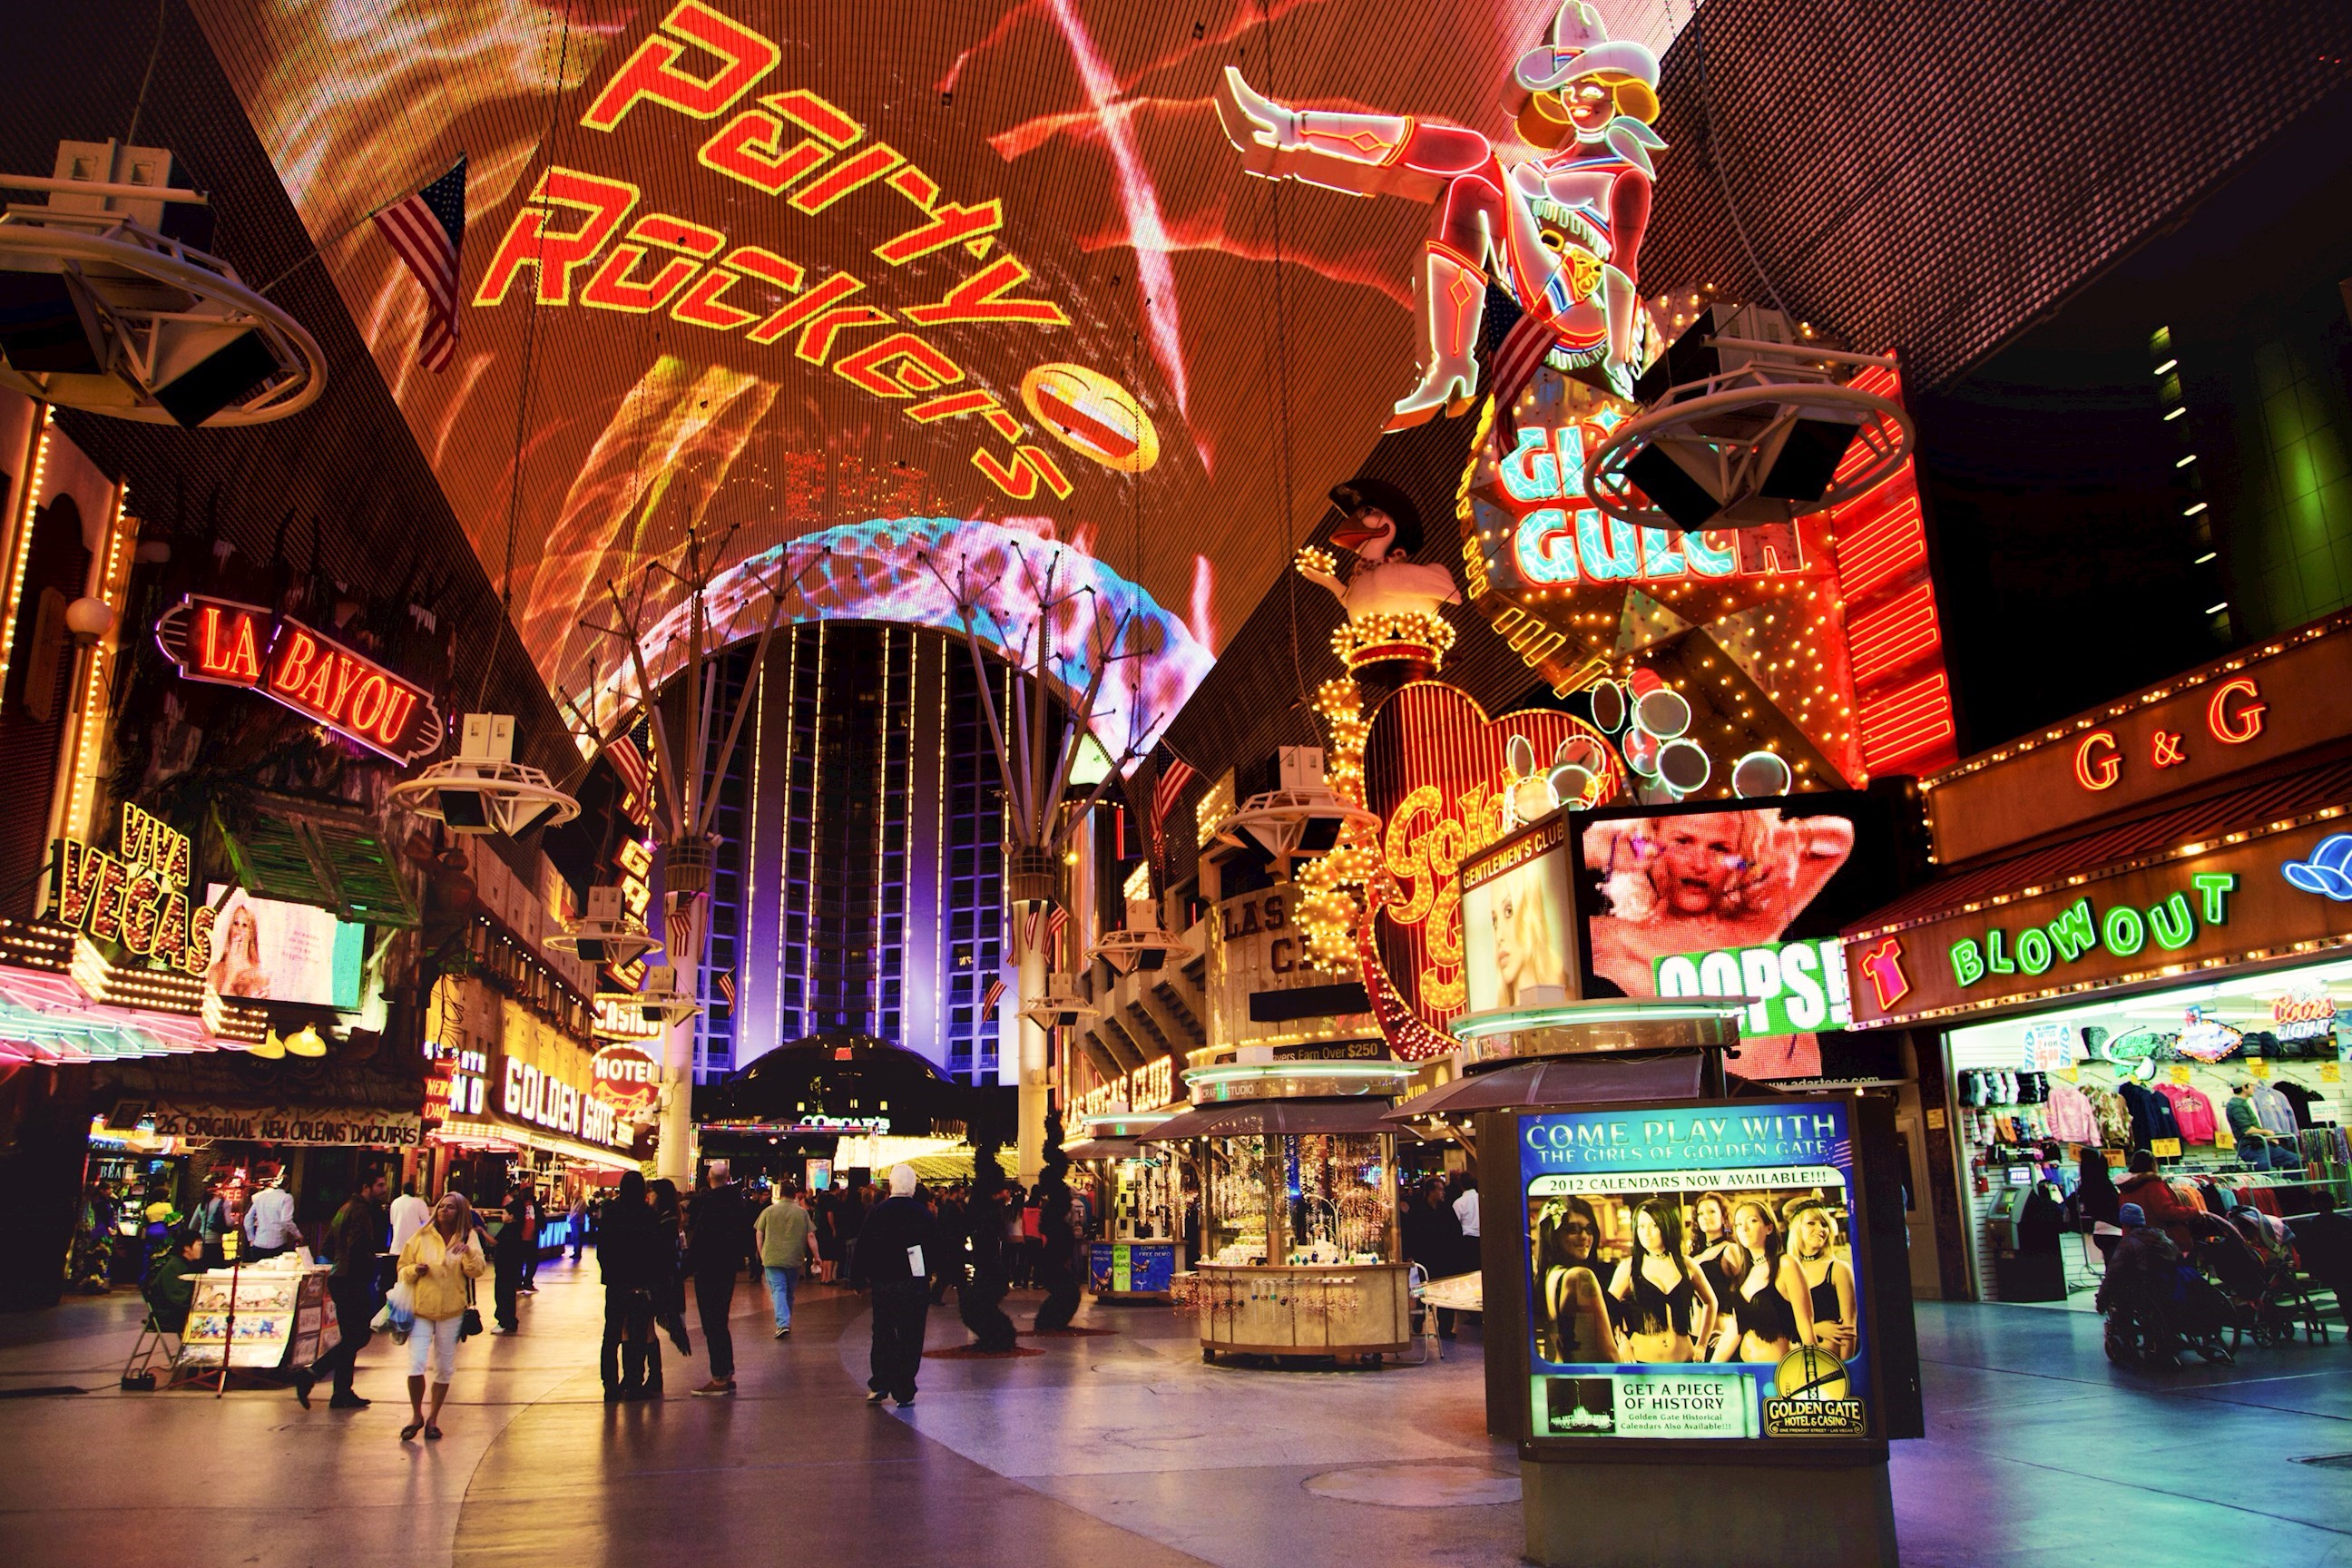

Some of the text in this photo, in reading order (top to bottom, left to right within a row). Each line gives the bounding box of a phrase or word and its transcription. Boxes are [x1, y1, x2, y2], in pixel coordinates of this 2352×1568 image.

[202, 607, 418, 744] LA BAYOU
[2075, 679, 2267, 790] G & G
[122, 801, 191, 887] VIVA
[1462, 821, 1565, 888] GENTLEMEN'S CLUB
[60, 837, 217, 977] VEGAS
[1223, 895, 1285, 942] LAS
[1948, 871, 2239, 989] BLOWOUT
[2276, 1019, 2335, 1041] LIGHT
[1322, 1047, 1346, 1059] Over
[1348, 1042, 1378, 1057] $250
[1132, 1054, 1173, 1113] CLUB
[1226, 1084, 1254, 1095] STUDIO
[505, 1055, 617, 1146] GOLDEN GATE
[156, 1114, 180, 1135] 26
[185, 1115, 256, 1139] ORIGINAL
[260, 1120, 288, 1140] NEW
[289, 1121, 348, 1142] ORLEANS
[1526, 1113, 1837, 1150] COME PLAY WITH
[1538, 1140, 1829, 1164] THE GIRLS OF GOLDEN GATE
[1550, 1171, 1828, 1191] 2012 CALENDARS NOW AVAILABLE!!!
[1623, 1383, 1725, 1396] GET A PIECE
[1624, 1397, 1724, 1410] OF HISTORY
[1628, 1412, 1723, 1421] Golden Gate Historical
[1769, 1401, 1860, 1420] GOLDEN GATE
[1621, 1422, 1732, 1431] Calendars Also Available!!!
[1784, 1416, 1847, 1426] HOTEL & CASINO
